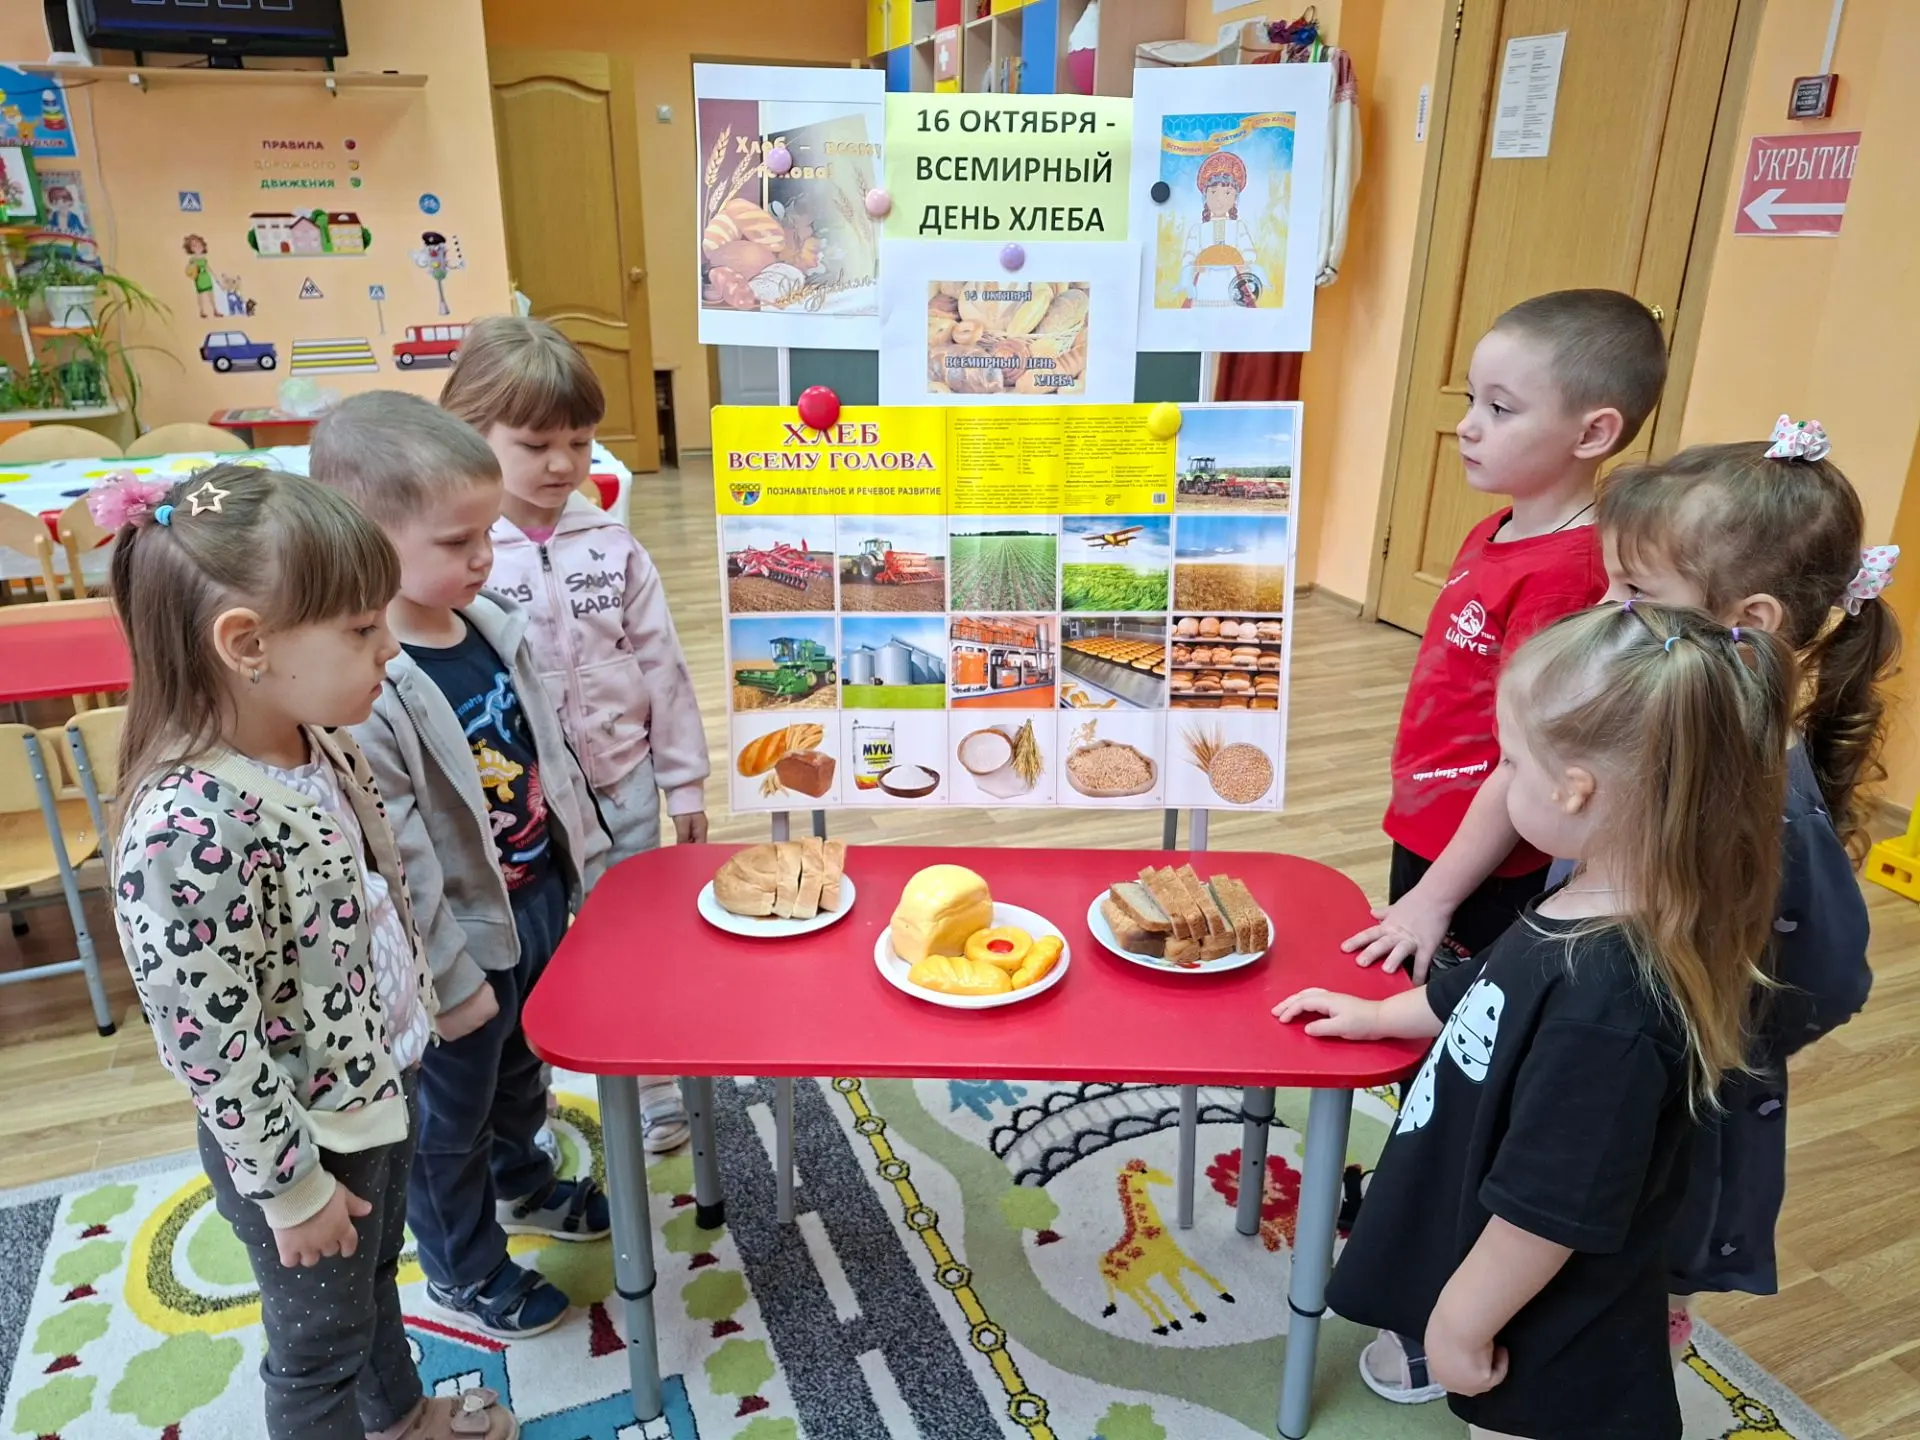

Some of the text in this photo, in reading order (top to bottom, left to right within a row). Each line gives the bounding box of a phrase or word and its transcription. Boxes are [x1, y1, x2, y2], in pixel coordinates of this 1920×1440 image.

[917, 109, 950, 132] 16
[960, 110, 1096, 133] ОКТЯБРЯ
[262, 140, 324, 150] ПРАВИЛА
[917, 151, 1112, 183] ВСЕМИРНЫЙ
[260, 179, 335, 189] ДВИЖЕНИЯ
[919, 205, 1105, 235] ДЕНЬ ХЛЕБА
[945, 352, 1057, 370] ВСЕМИРНЫЙ ДЕНЬ
[1033, 374, 1075, 387] ХЛЕБА
[783, 423, 880, 445] ХЛЕБ
[728, 452, 820, 470] ВСЕМУ
[829, 452, 935, 471] ГОЛОВА
[766, 486, 941, 496] ПОЗНАВАТЕЛЬНОЕ И РЕЧЕВОЕ РАЗВИТИЕ
[863, 743, 893, 756] МУКА
